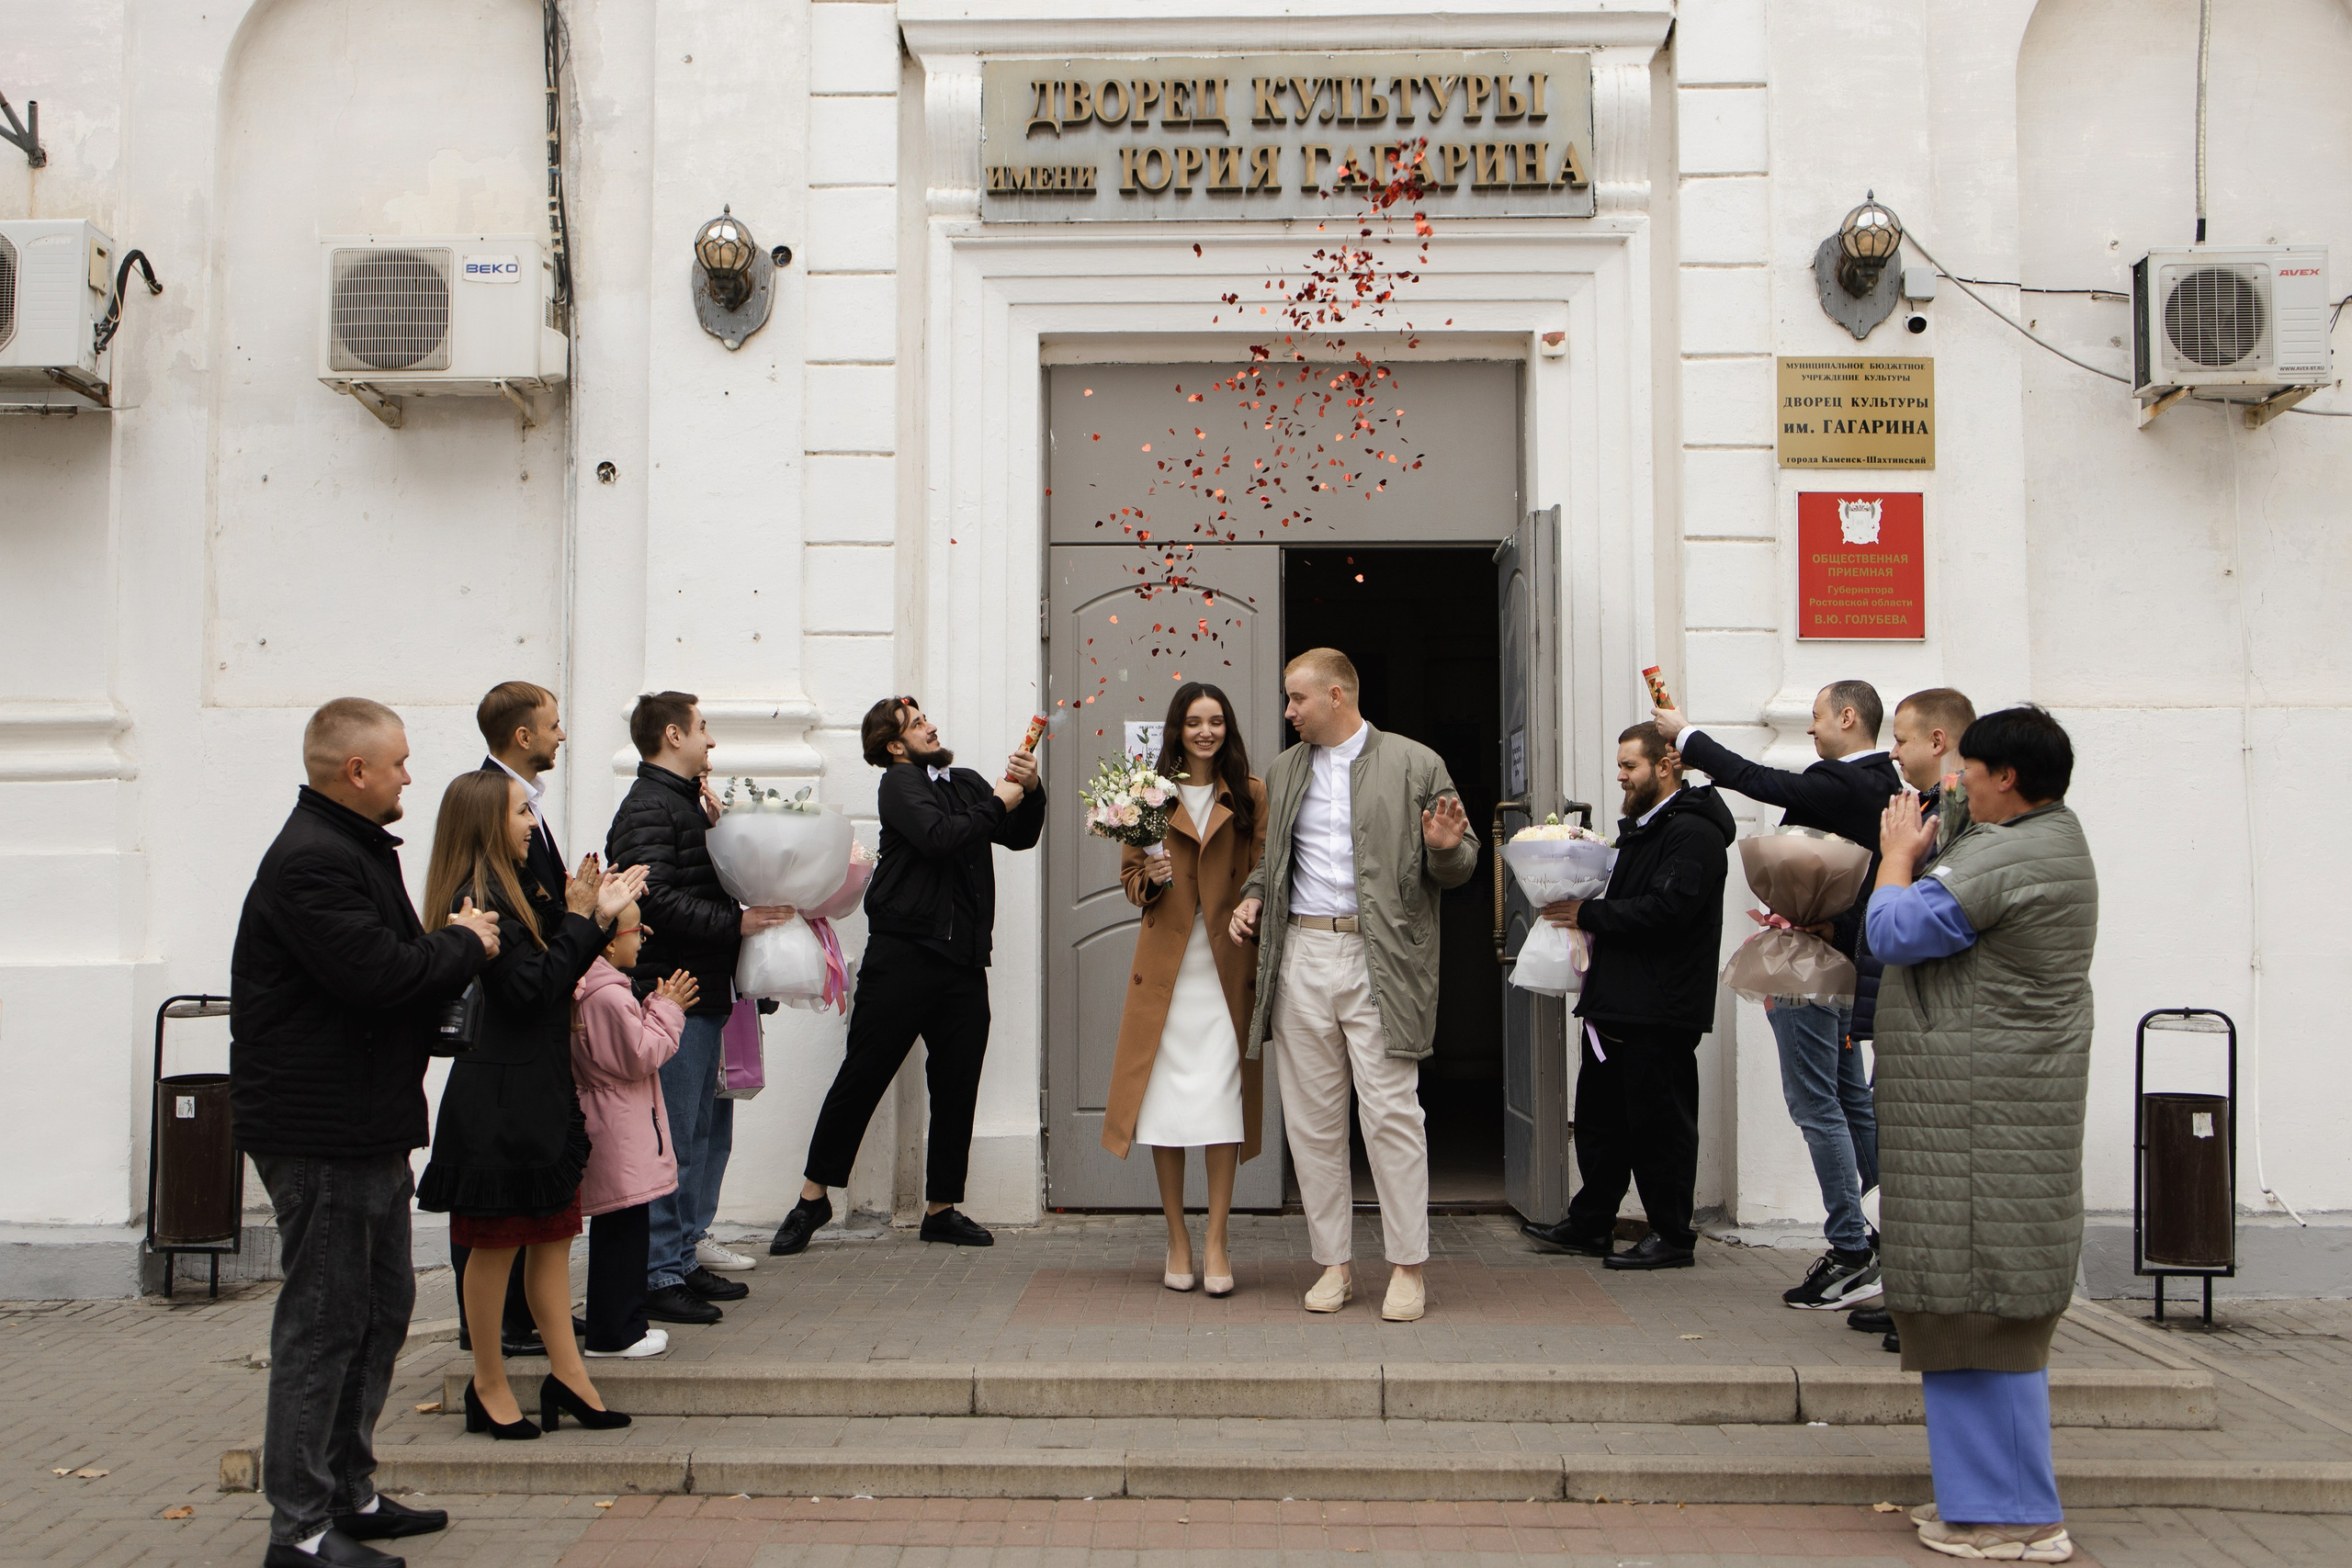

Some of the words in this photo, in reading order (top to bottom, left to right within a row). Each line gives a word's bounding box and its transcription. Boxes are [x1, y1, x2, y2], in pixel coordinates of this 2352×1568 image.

[1025, 77, 1230, 139] ДВОРЕЦ
[1250, 72, 1549, 125] КУЛЬТУРЫ
[985, 164, 1097, 196] ИМЕНИ
[1118, 145, 1282, 195] ЮРИЯ
[465, 264, 518, 274] BEKO
[2278, 268, 2322, 276] AVEX
[1785, 362, 1865, 370] МУНИЦИПАЛЬНОЕ
[1869, 362, 1926, 371] БЮДЖЕТНОЕ
[1864, 374, 1911, 382] КУЛЬТУРЫ
[1782, 397, 1843, 410] ДВОРЕЦ
[1850, 397, 1928, 408] КУЛЬТУРЫ
[1783, 423, 1815, 434] им.
[1823, 419, 1928, 434] ГАГАРИНА
[1786, 457, 1818, 465] города
[1822, 456, 1927, 465] Каменск-Шахтинский
[1812, 554, 1908, 565] ОБЩЕСТВЕННАЯ
[1827, 567, 1894, 577] ПРИЕМНАЯ
[1827, 585, 1894, 595] Губернатора
[1809, 598, 1869, 607] Ростовской
[1871, 598, 1913, 607] области
[1815, 615, 1842, 625] В.Ю.
[1845, 615, 1907, 625] ГОЛУБЕВА
